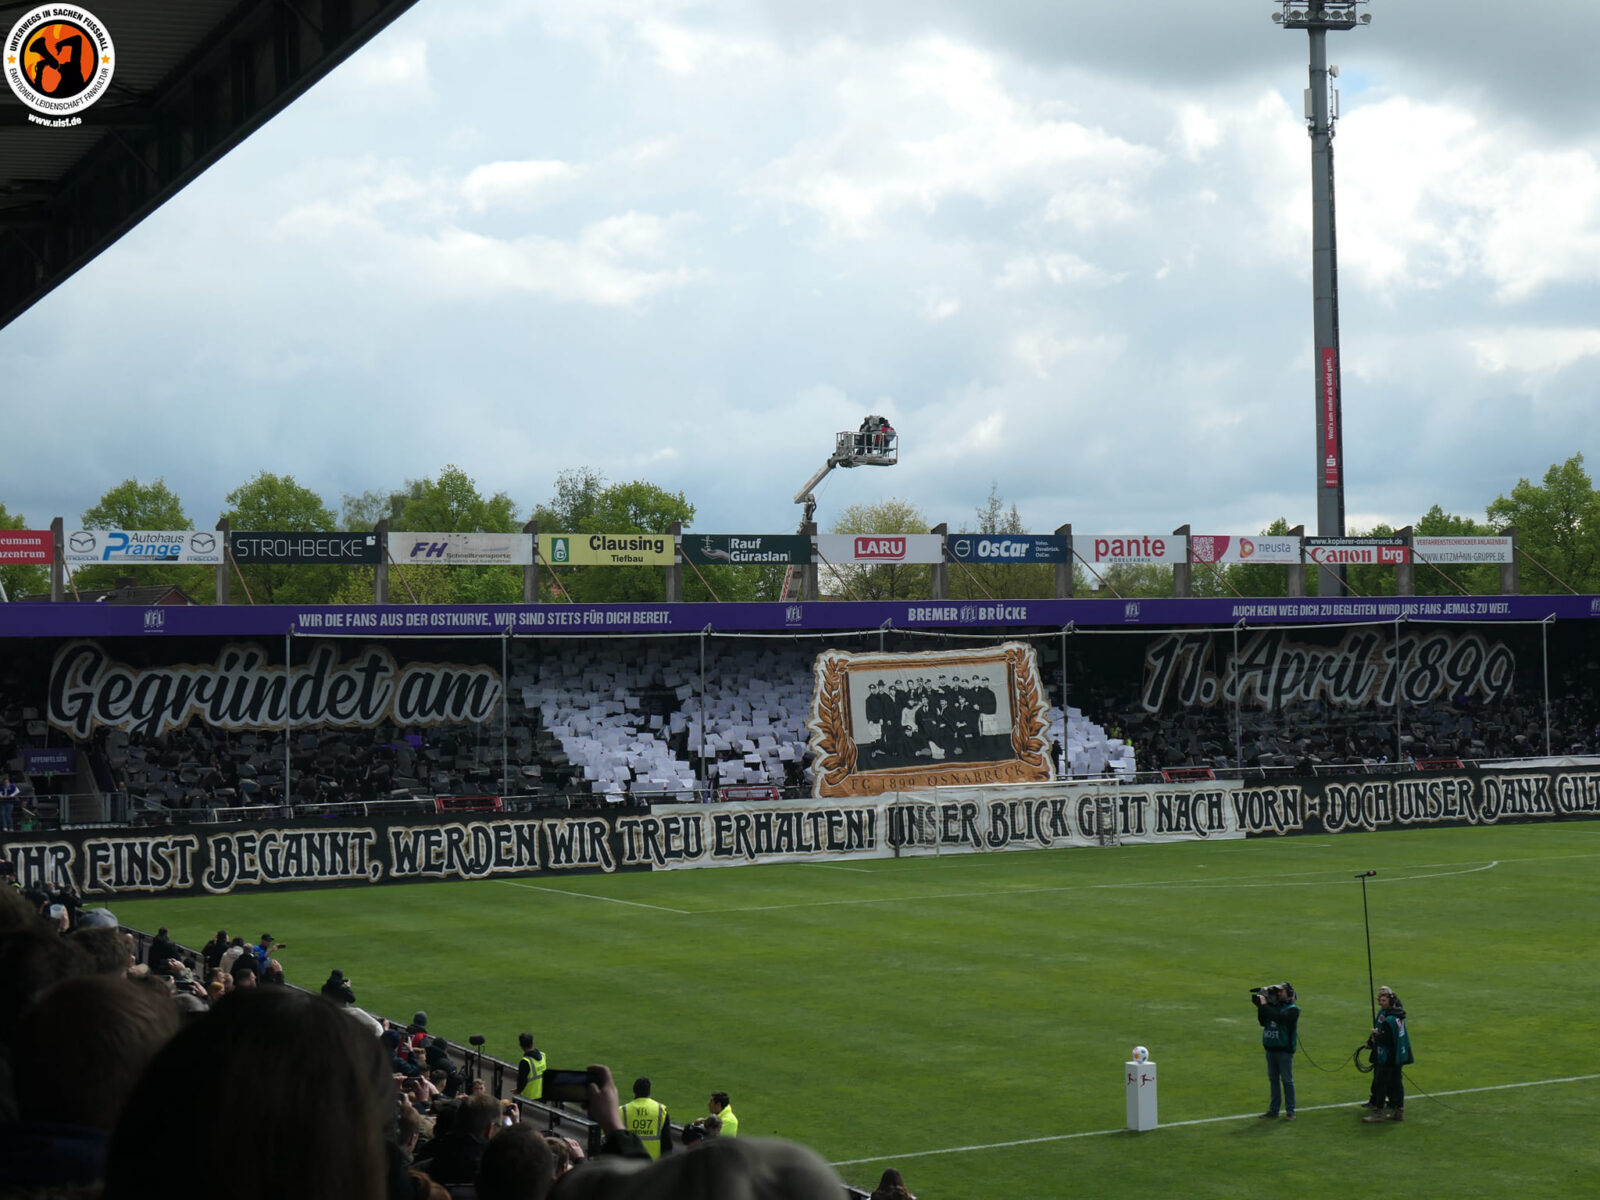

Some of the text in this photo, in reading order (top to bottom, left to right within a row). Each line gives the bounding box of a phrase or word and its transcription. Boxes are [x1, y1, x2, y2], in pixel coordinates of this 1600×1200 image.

[130, 532, 184, 544] Autohaus
[589, 535, 664, 553] Clausing
[730, 538, 761, 549] Rauf
[102, 533, 181, 560] Prange
[236, 539, 363, 557] STROHBECKE
[410, 542, 448, 558] FH
[858, 541, 903, 554] LARU
[977, 540, 1029, 558] OsCar
[1095, 535, 1165, 562] pante
[1259, 543, 1291, 553] neusta
[730, 550, 788, 562] Güraslan
[1311, 547, 1372, 563] Canon
[1382, 548, 1403, 563] brg
[299, 609, 672, 627] WIR DIE FANS AUS DER OSTKURVE, WIR SIND STETS FÜR DICH BEREIT.
[908, 608, 958, 621] BREMER
[979, 604, 1027, 620] BRÜCKE
[1232, 603, 1511, 617] AUCH KEIN WEG DICH ZU BEGLEITEN WIRD UNS FANS JEMALS ZU WEIT.
[1144, 630, 1516, 711] 17. April 1899
[51, 642, 500, 739] Gegründet am
[851, 779, 871, 790] FC
[7, 844, 78, 893] IHR
[87, 838, 197, 890] EINST
[206, 829, 381, 890] BEGANNT,
[391, 821, 541, 878] WERDEN
[545, 818, 614, 871] WIR
[617, 812, 703, 867] TREU
[713, 807, 877, 859] ERHALTEN!
[885, 802, 983, 849] UNSER
[987, 797, 1070, 847] BLICK
[1077, 793, 1149, 837] GEHT
[1154, 790, 1226, 837] NACH
[1230, 786, 1302, 832] VORN
[1325, 783, 1391, 831] DOCH
[1396, 777, 1477, 823] UNSER
[1480, 775, 1553, 822] DANK
[632, 1119, 653, 1130] 097
